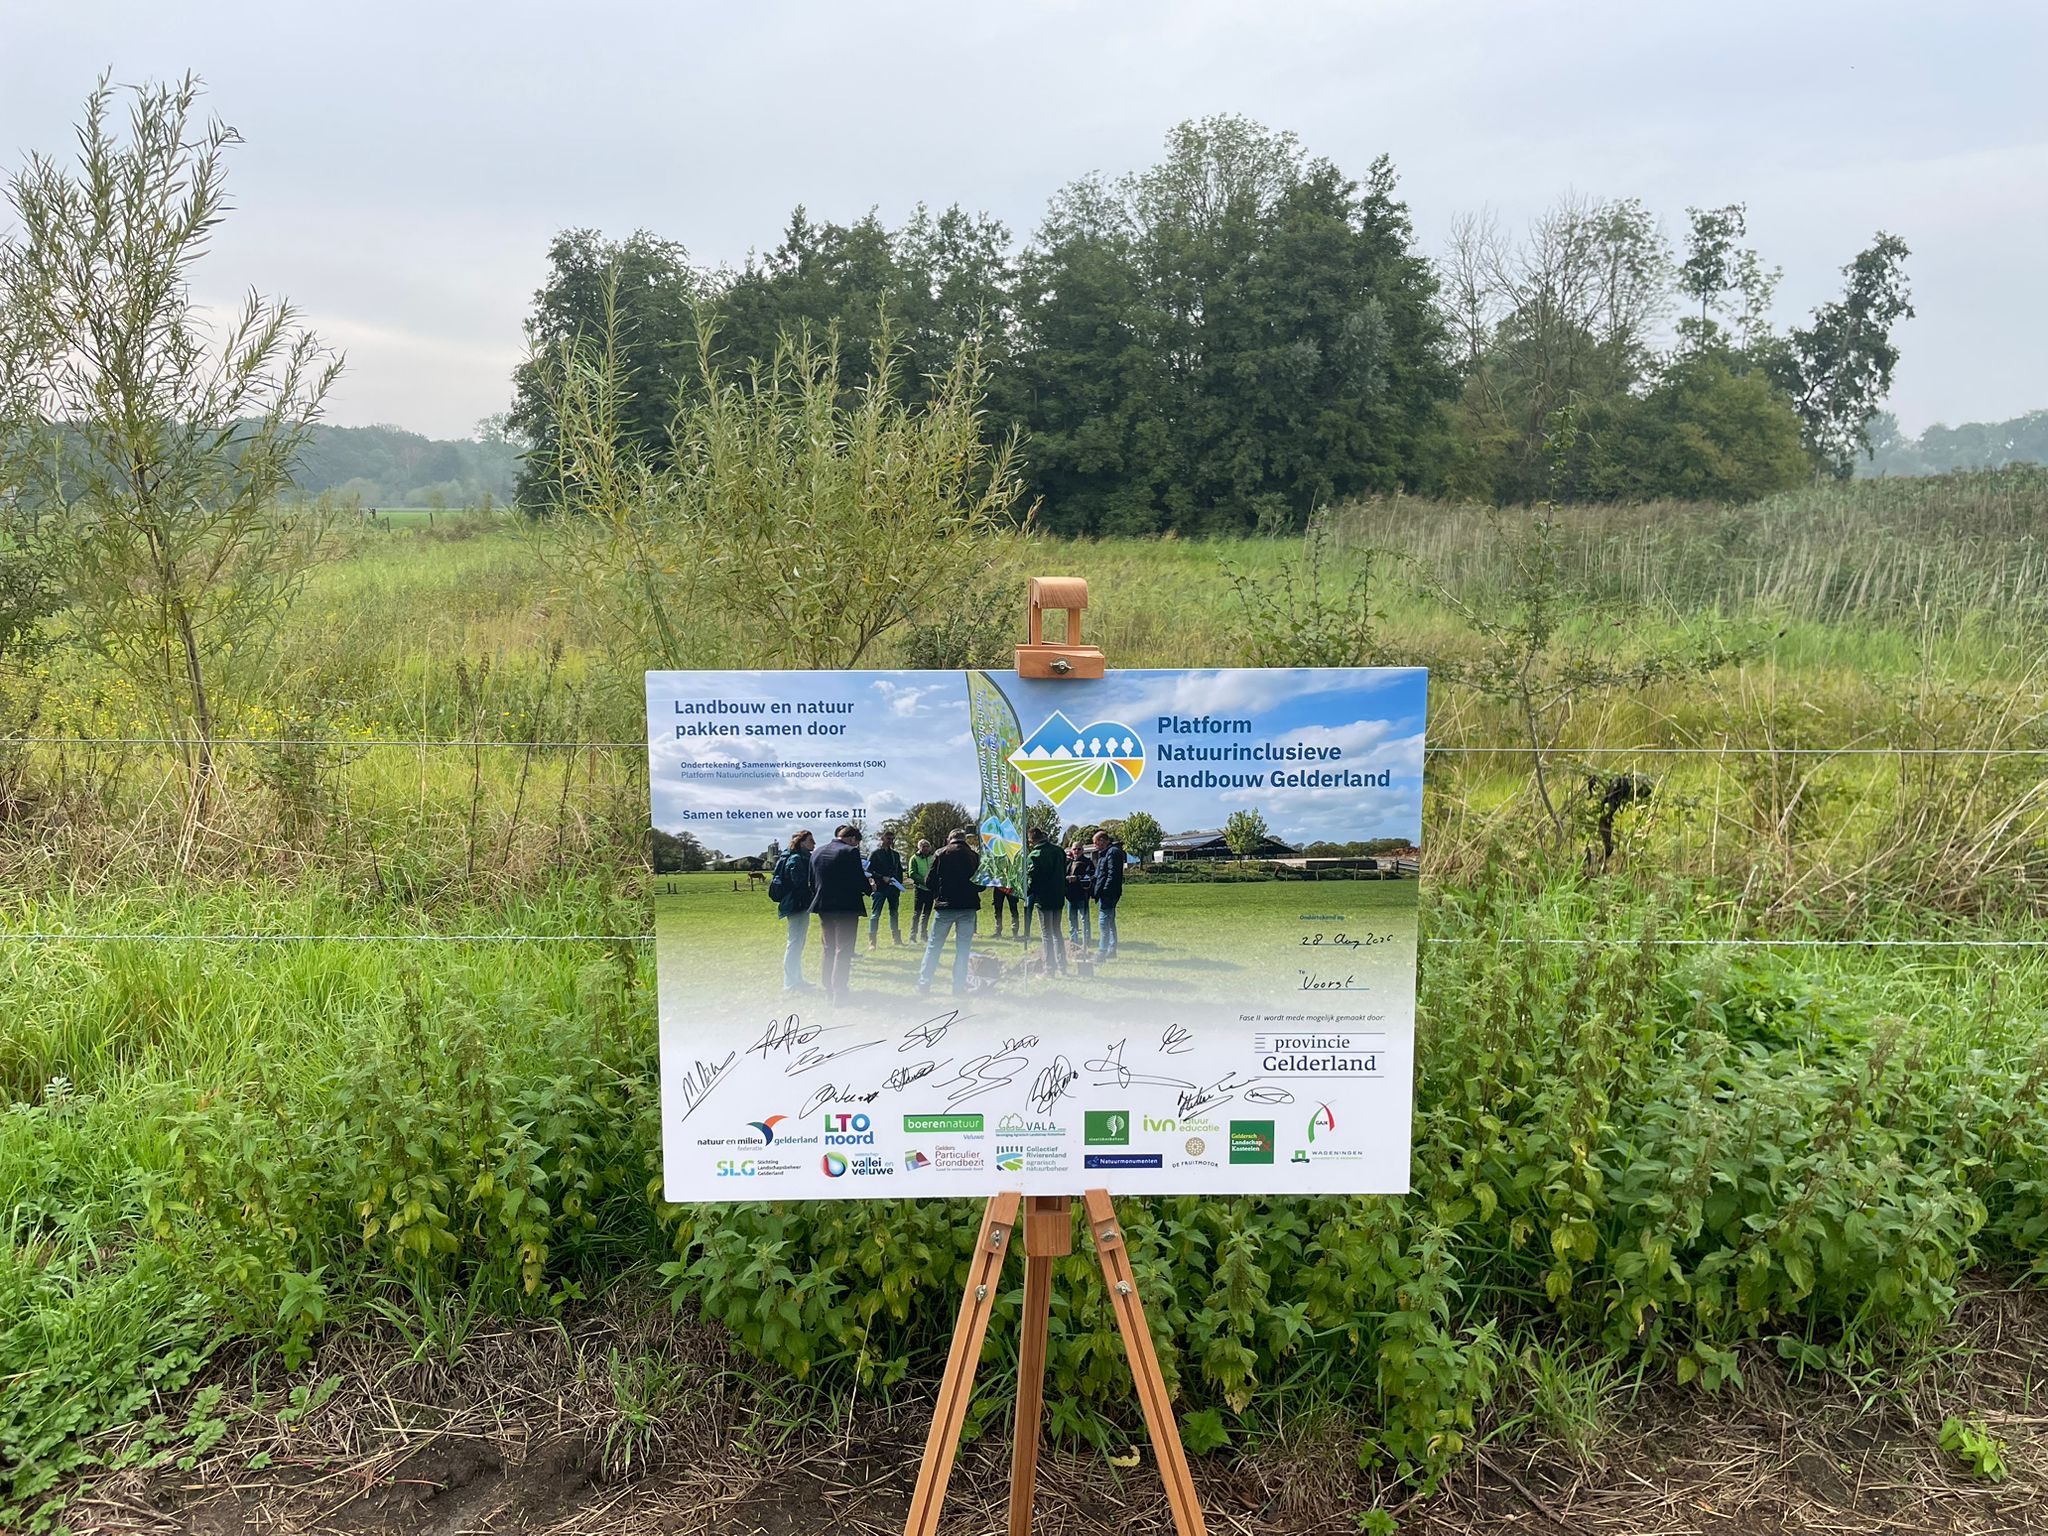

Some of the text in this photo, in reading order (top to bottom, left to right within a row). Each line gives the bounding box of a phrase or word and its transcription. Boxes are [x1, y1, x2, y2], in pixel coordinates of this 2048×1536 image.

[674, 700, 854, 715] Landbouw en natuur
[675, 721, 846, 739] pakken samen door
[1157, 716, 1252, 734] Platform
[1157, 742, 1342, 761] Natuurinclusieve
[680, 760, 886, 770] Ondertekening Samenwerkingsovereenkomst (SOK)
[681, 770, 864, 779] Platform Natuurinclusieve Landbouw Gelderland
[1157, 769, 1390, 789] landbouw Gelderland
[682, 810, 724, 820] Samen
[726, 809, 774, 820] tekenen
[776, 811, 794, 819] we
[824, 808, 849, 818] fase
[851, 808, 867, 818] II!
[1302, 933, 1323, 945] 28
[1303, 974, 1354, 989] Voorst
[1306, 1014, 1335, 1023] mogelijk
[1335, 1014, 1366, 1023] gemaakt
[1275, 1035, 1351, 1052] provincie
[1263, 1055, 1377, 1072] Gelderland
[824, 1113, 871, 1133] LTO
[908, 1119, 980, 1129] boerennatuur
[1026, 1121, 1057, 1131] VALA
[1143, 1114, 1176, 1132] ivn
[1179, 1117, 1209, 1125] natuur
[1179, 1124, 1220, 1132] educatie
[697, 1138, 725, 1146] natuur
[737, 1137, 763, 1145] milieu
[774, 1136, 819, 1146] gelderland
[825, 1131, 875, 1145] noord
[935, 1151, 980, 1159] Particulier
[716, 1159, 755, 1177] SLG
[851, 1157, 882, 1168] vallei
[935, 1158, 985, 1167] Grondbezit
[1181, 1160, 1219, 1168] FRUITMOTOR
[851, 1167, 894, 1176] veluwe
